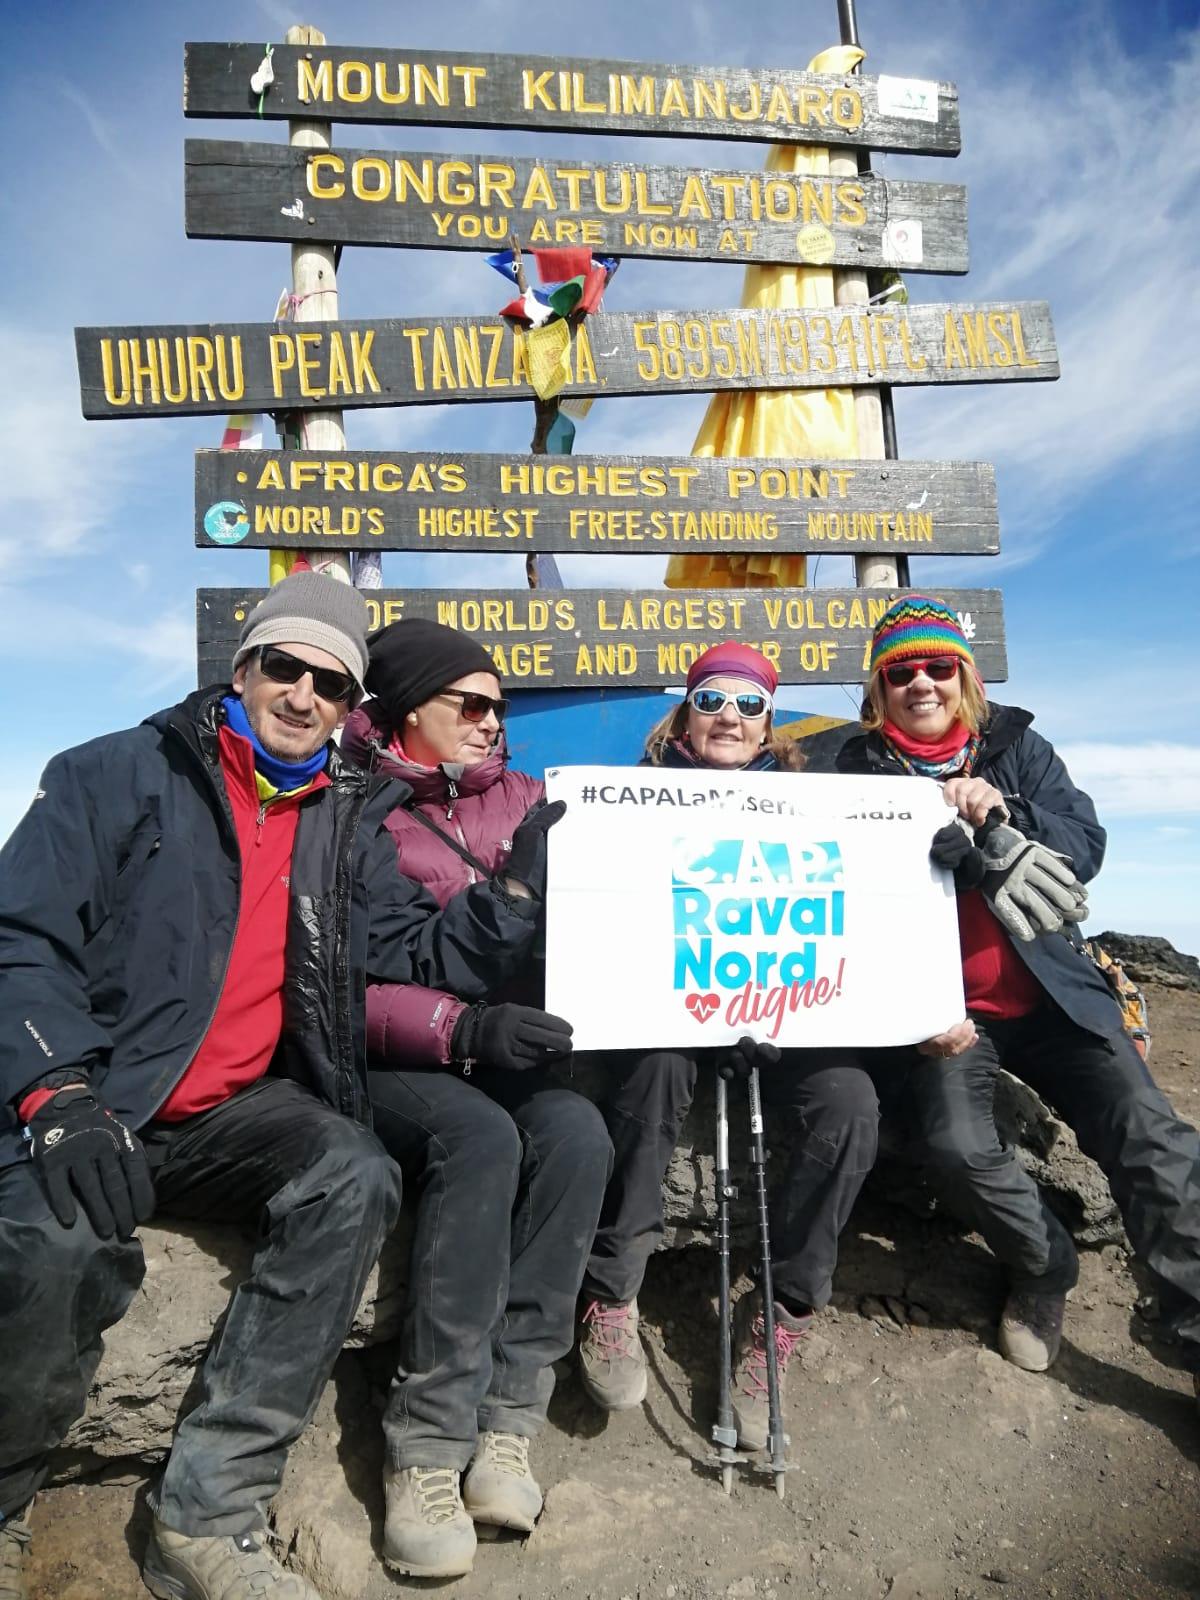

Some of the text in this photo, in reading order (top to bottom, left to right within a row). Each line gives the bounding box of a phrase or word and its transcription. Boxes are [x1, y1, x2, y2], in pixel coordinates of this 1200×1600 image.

[297, 58, 863, 129] MOUNT KILIMANJARO
[306, 153, 868, 227] CONGRATULATIONS
[431, 212, 758, 253] YOU ARE NOW AT
[100, 333, 245, 406] UHURU
[269, 330, 382, 399] PEAK
[944, 310, 1040, 370] AMSL
[256, 460, 857, 500] AFRICA'S HIGHEST POINT
[254, 504, 385, 536] WORLD'S
[418, 508, 539, 539] HIGHEST
[807, 511, 934, 542] MOUNTAIN
[437, 599, 576, 633] WORLD'S
[598, 599, 745, 631] LARGEST
[576, 642, 638, 676] AND
[800, 641, 840, 671] OF
[672, 888, 846, 936] Raval
[673, 937, 818, 990] Nord
[724, 957, 846, 1039] digne!
